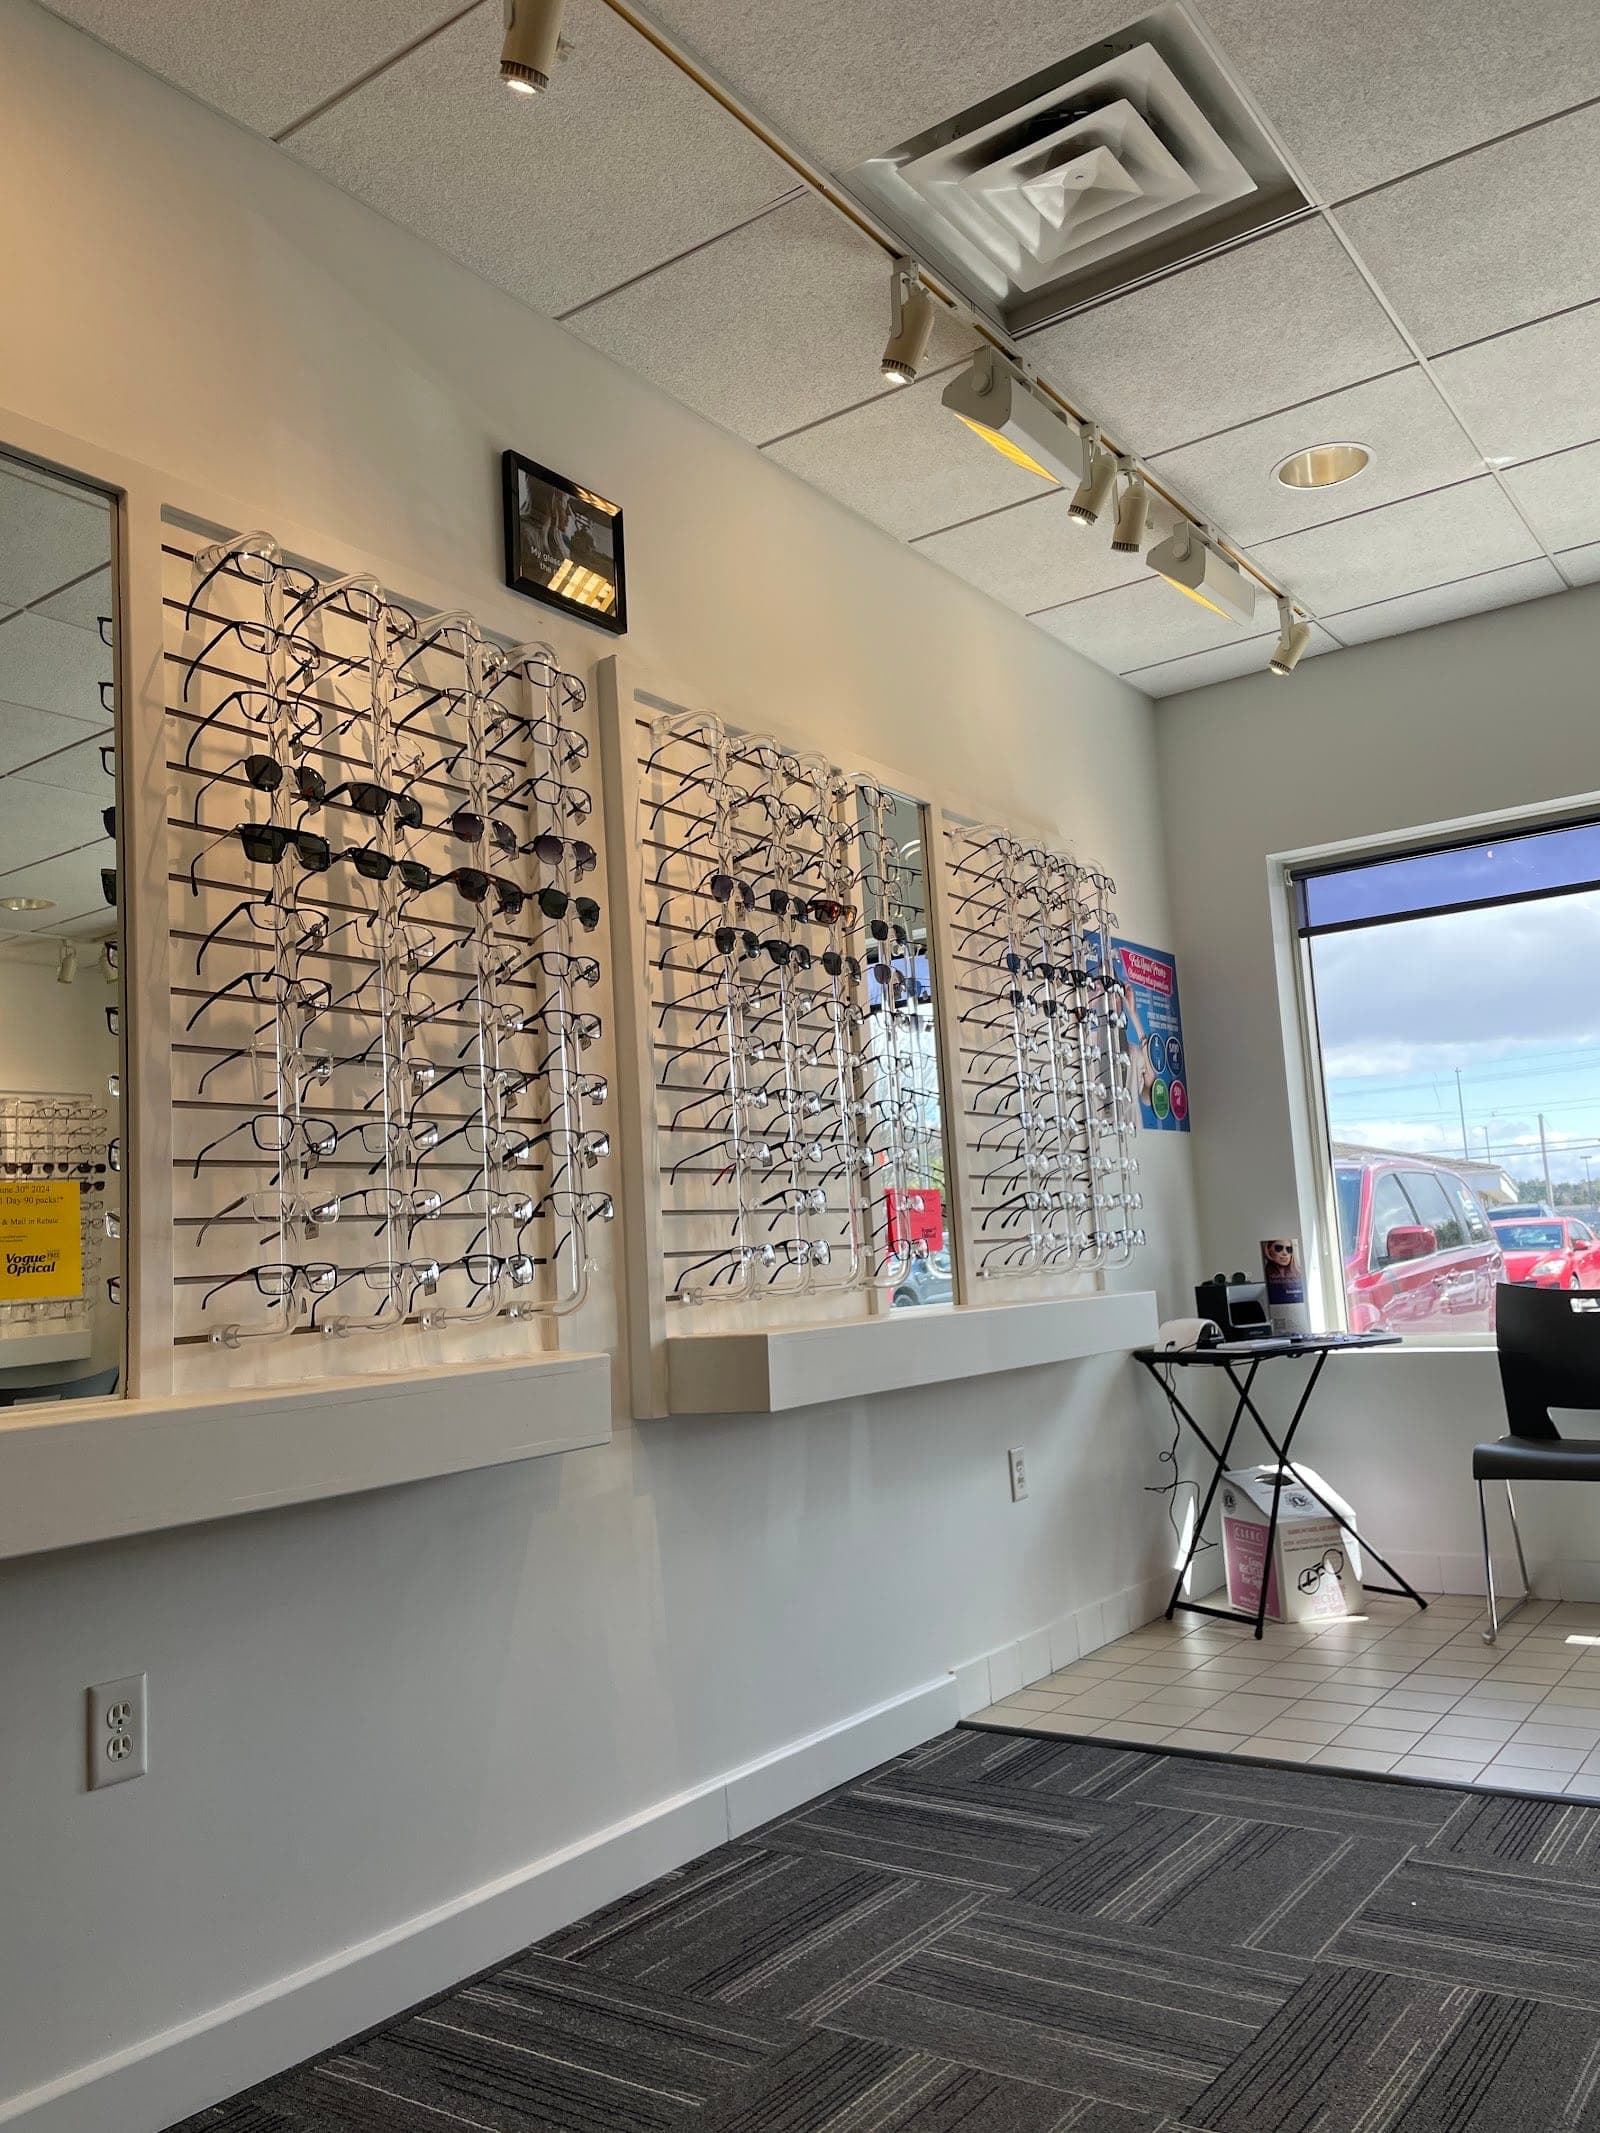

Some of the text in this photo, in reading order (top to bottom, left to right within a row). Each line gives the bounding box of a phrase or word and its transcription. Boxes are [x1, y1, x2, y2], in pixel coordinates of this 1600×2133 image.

[531, 546, 541, 559] My
[32, 1185, 50, 1193] 2024
[6, 1196, 21, 1206] Day
[6, 1253, 47, 1265] Vogue
[7, 1262, 56, 1276] Optical
